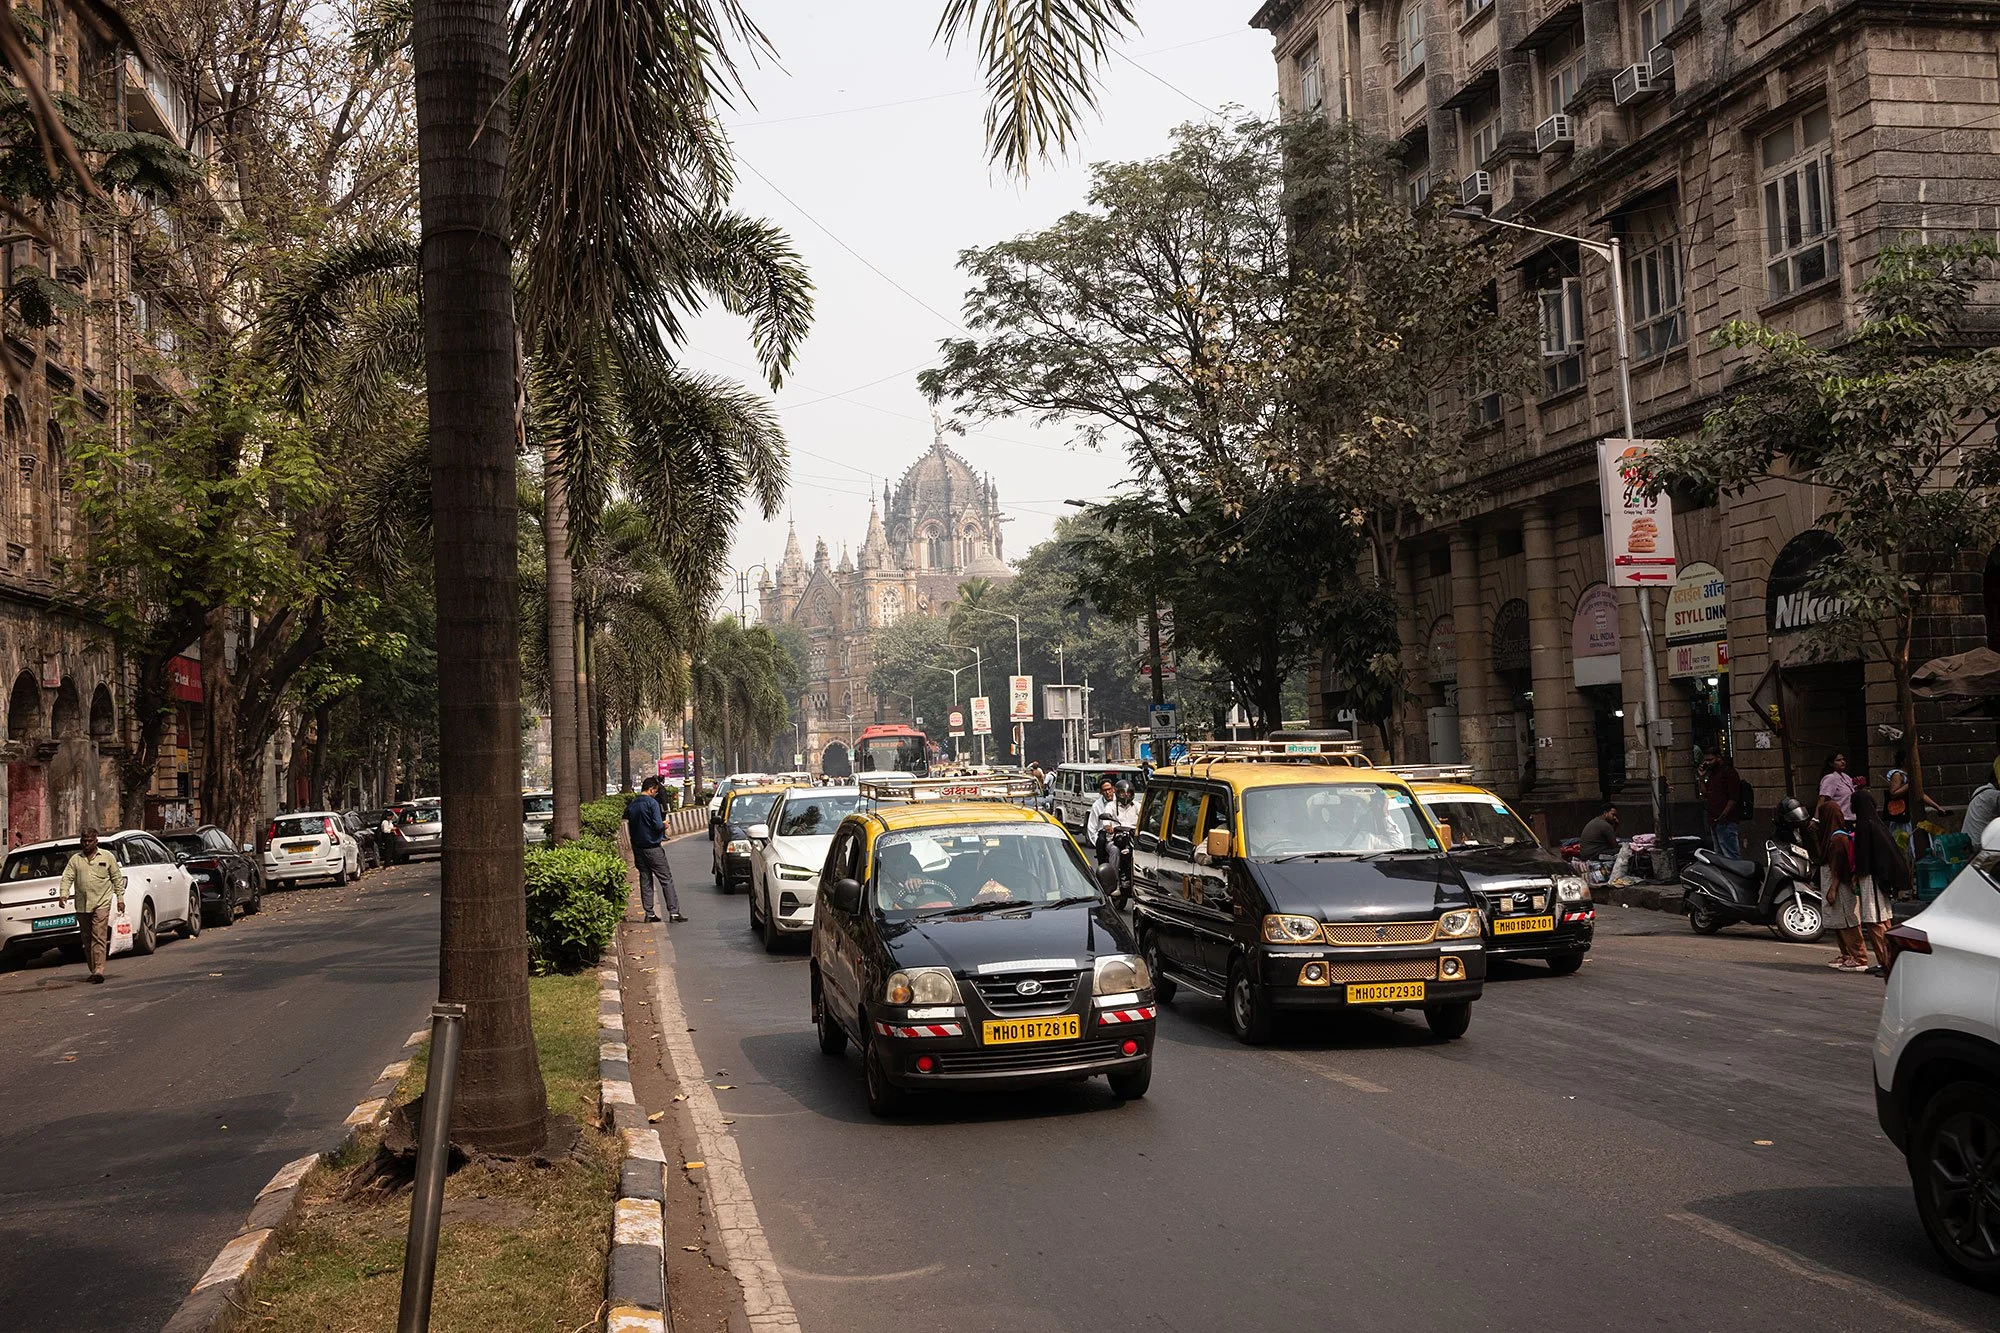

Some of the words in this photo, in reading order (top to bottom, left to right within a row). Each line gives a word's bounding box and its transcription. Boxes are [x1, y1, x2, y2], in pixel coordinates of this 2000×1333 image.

[1674, 608, 1704, 626] STYLL
[1705, 604, 1726, 621] ONN
[1775, 590, 1850, 630] Nikon
[1590, 634, 1600, 642] ALL
[1600, 632, 1615, 641] INDIA
[942, 785, 978, 796] अक्षय
[1500, 918, 1552, 932] MH01BD2101
[1355, 985, 1423, 1000] MH03CP2938
[993, 1021, 1077, 1041] MH01BT2816
